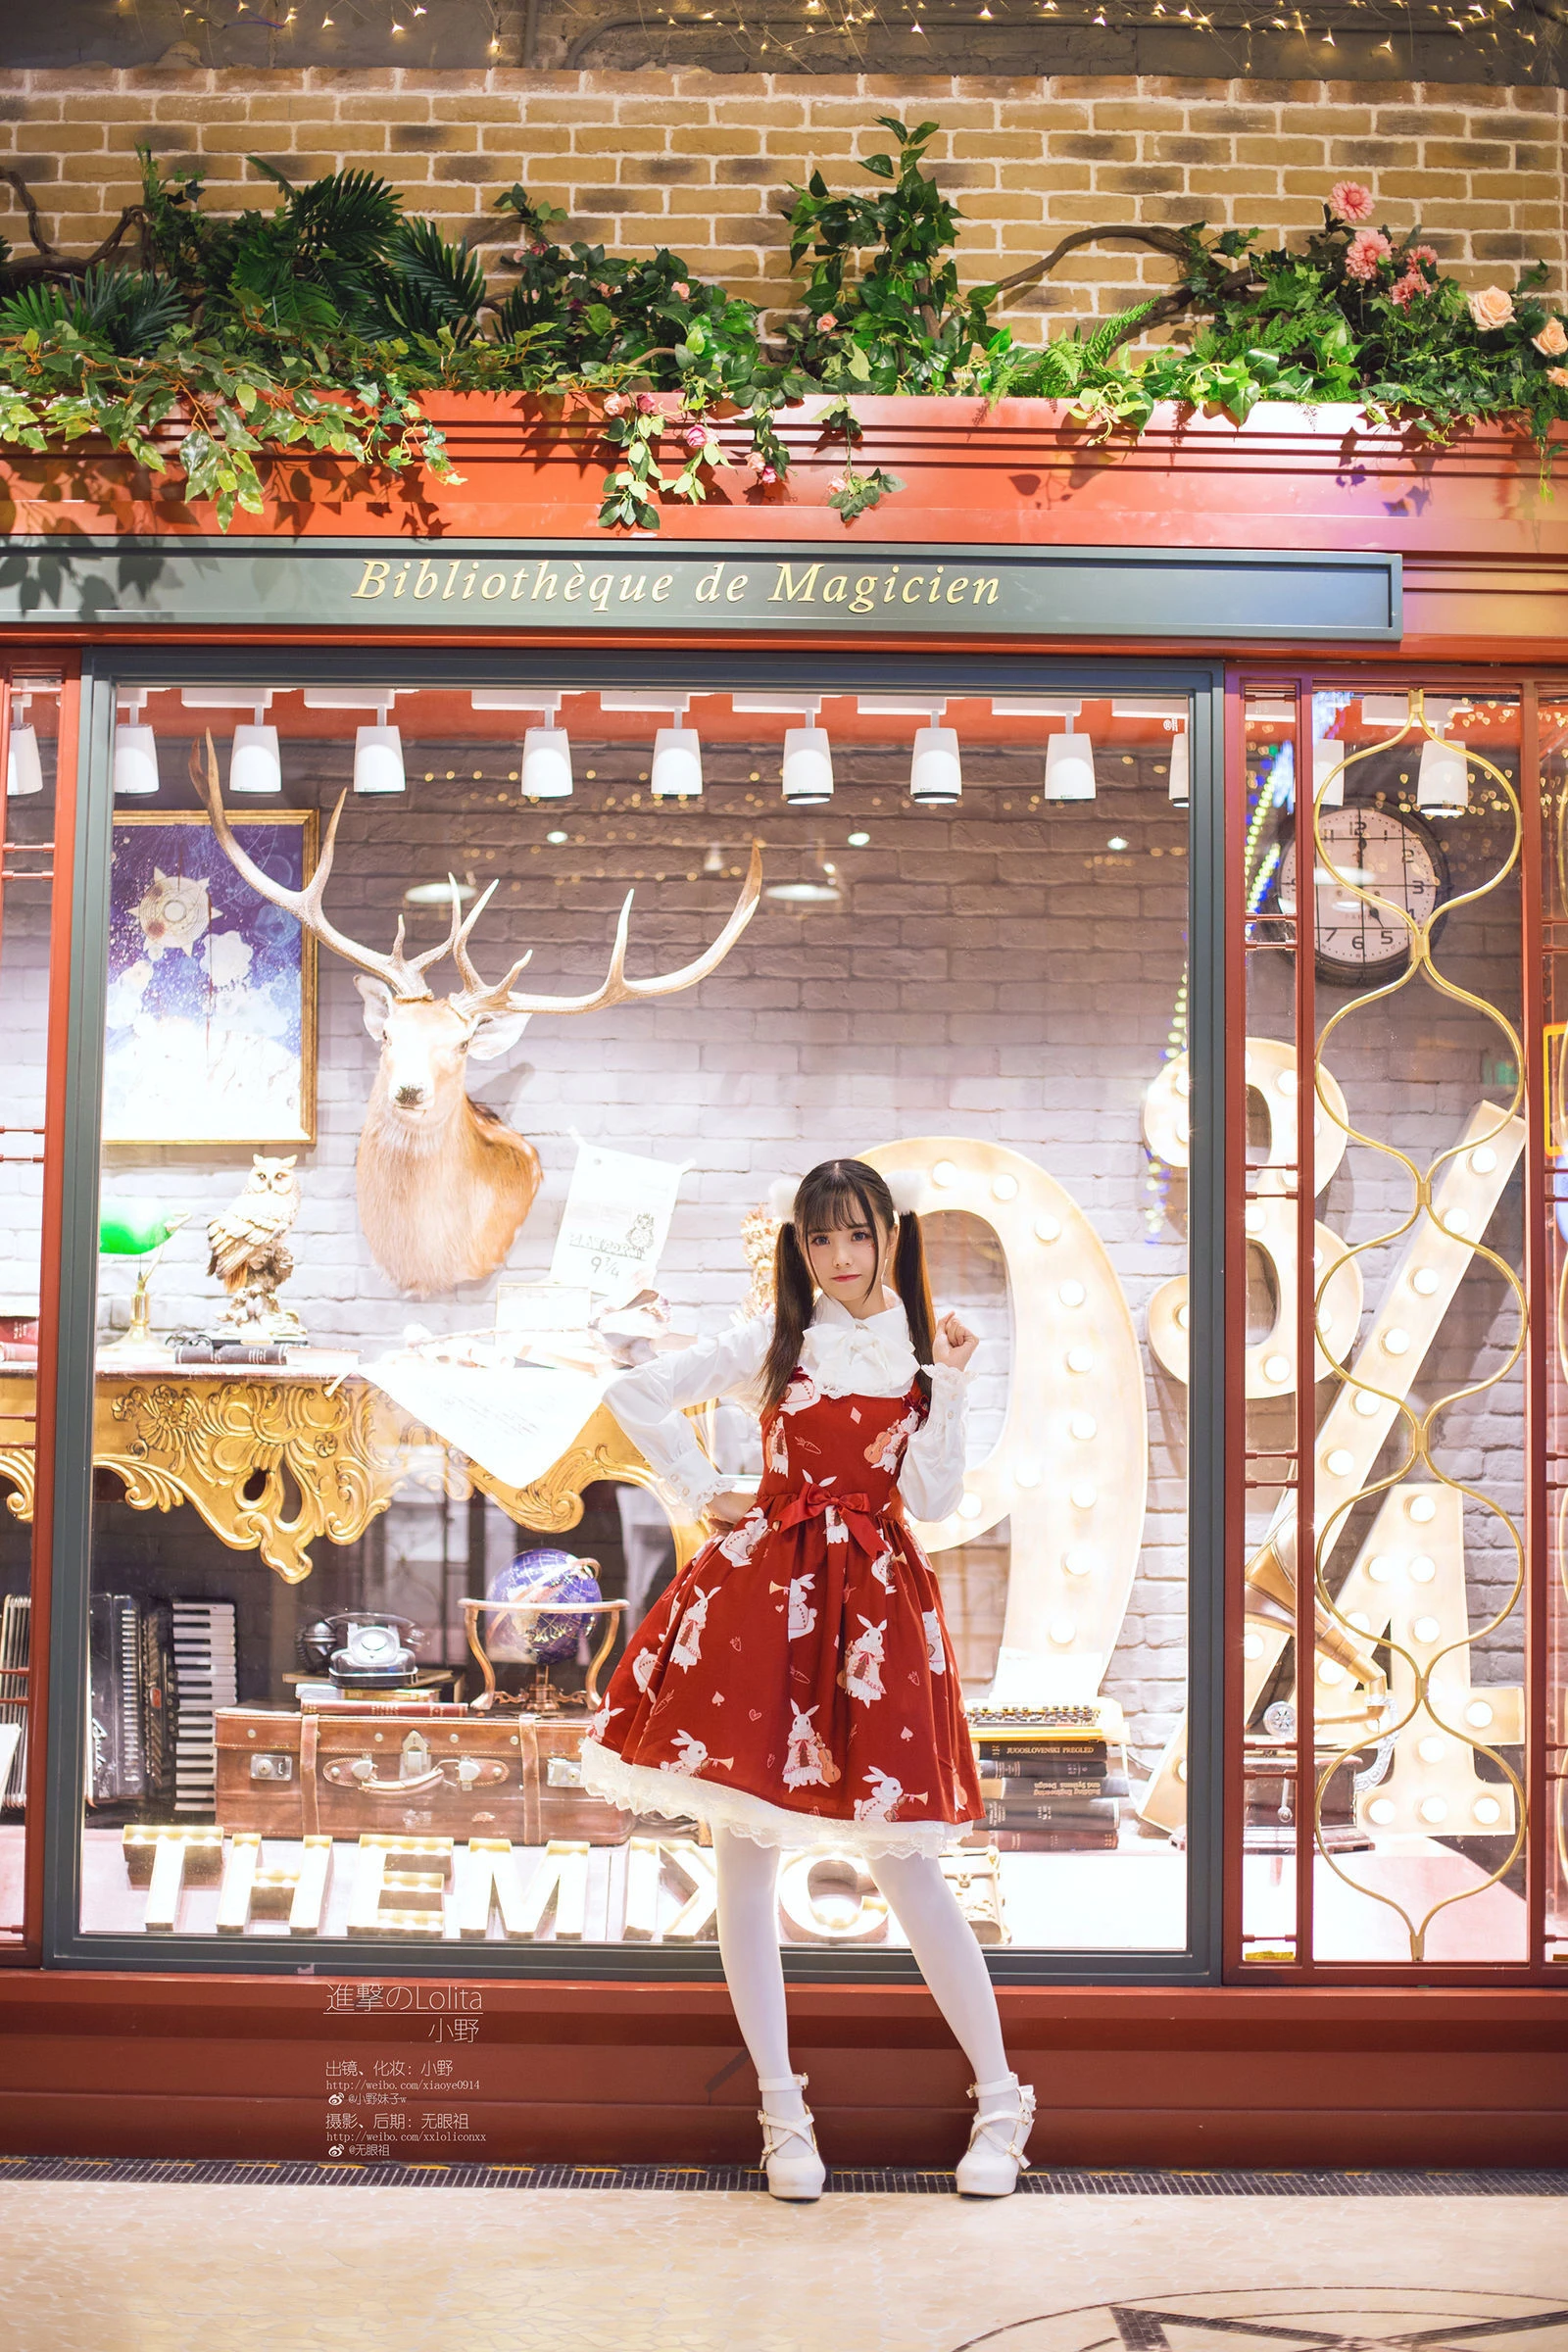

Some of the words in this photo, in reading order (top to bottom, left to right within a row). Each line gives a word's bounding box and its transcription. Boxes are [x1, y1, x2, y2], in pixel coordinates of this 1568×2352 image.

[351, 559, 670, 613] Bibliothèque
[695, 563, 749, 605] de
[766, 562, 1001, 613] Magicien
[1412, 880, 1424, 895] 3
[1324, 927, 1338, 942] 7
[1381, 930, 1394, 945] 5
[1351, 936, 1363, 950] 6
